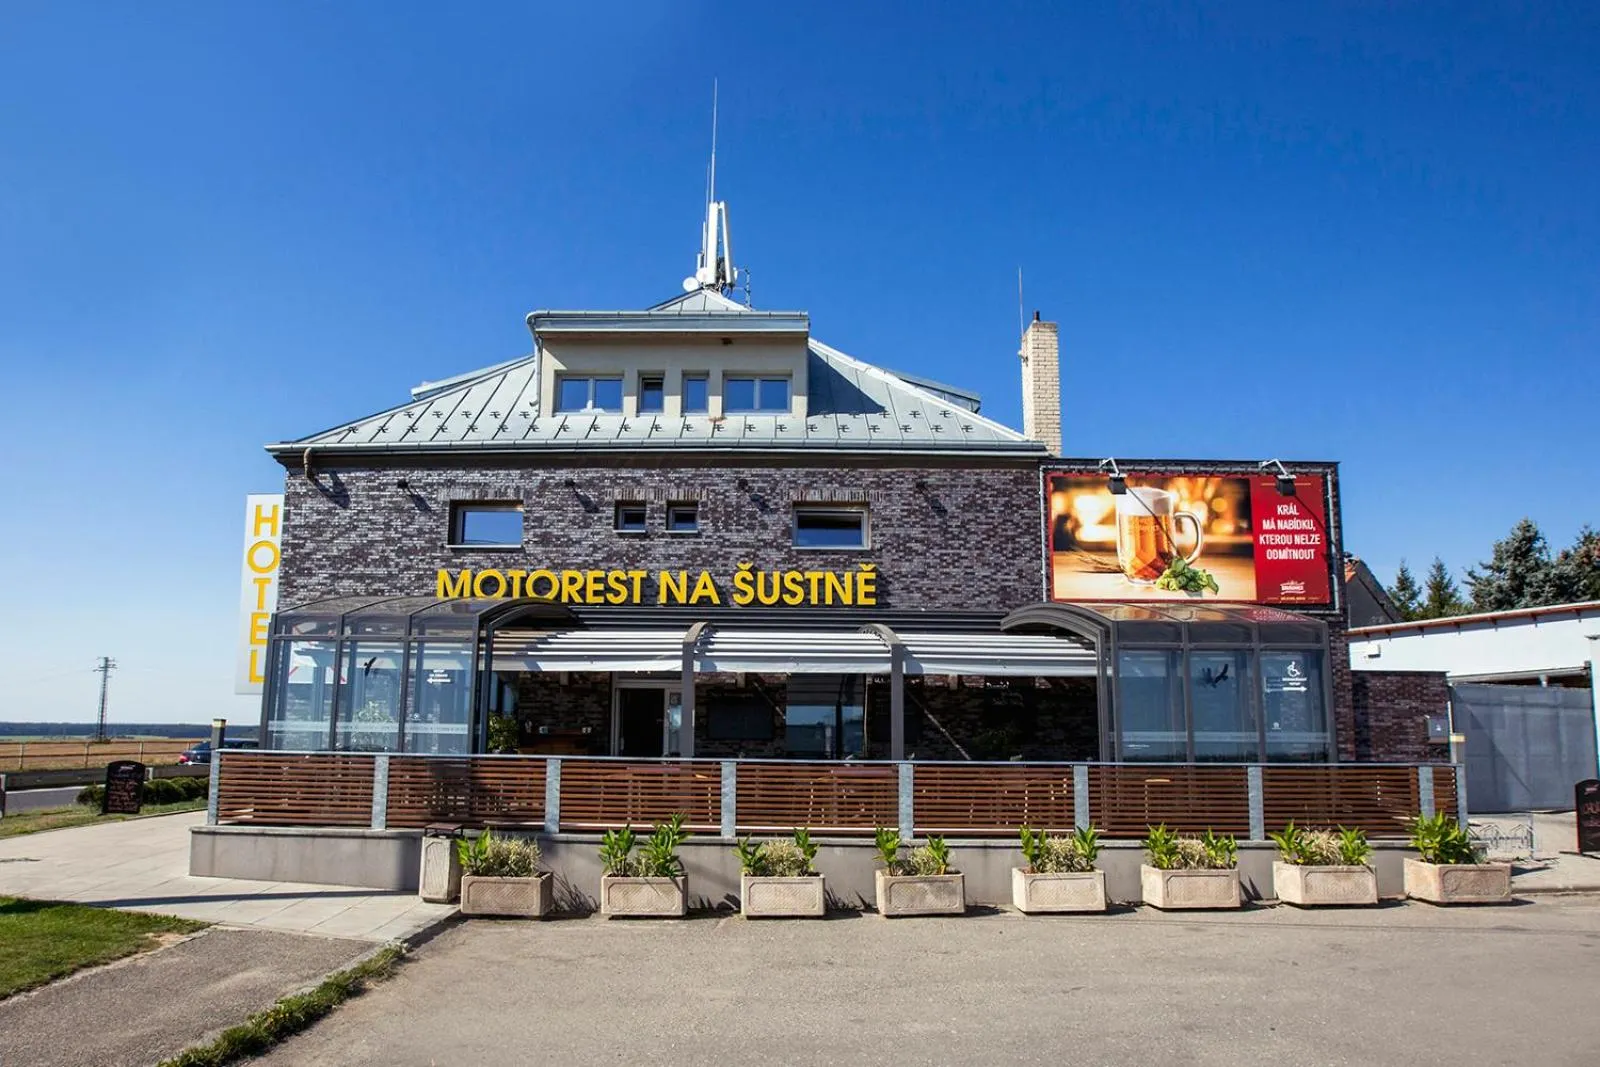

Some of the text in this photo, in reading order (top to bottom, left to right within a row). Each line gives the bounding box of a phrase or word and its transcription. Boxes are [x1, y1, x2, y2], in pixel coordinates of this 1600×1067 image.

[1277, 502, 1299, 515] KRÁL
[1262, 517, 1316, 531] MÁ NABÍDKU,
[1259, 534, 1321, 545] KTEROU NELZE
[1266, 547, 1315, 560] ODMÍTNOUT
[436, 562, 877, 606] MOTOREST NA ŠUSTNĚ
[247, 504, 281, 683] HOTEL
